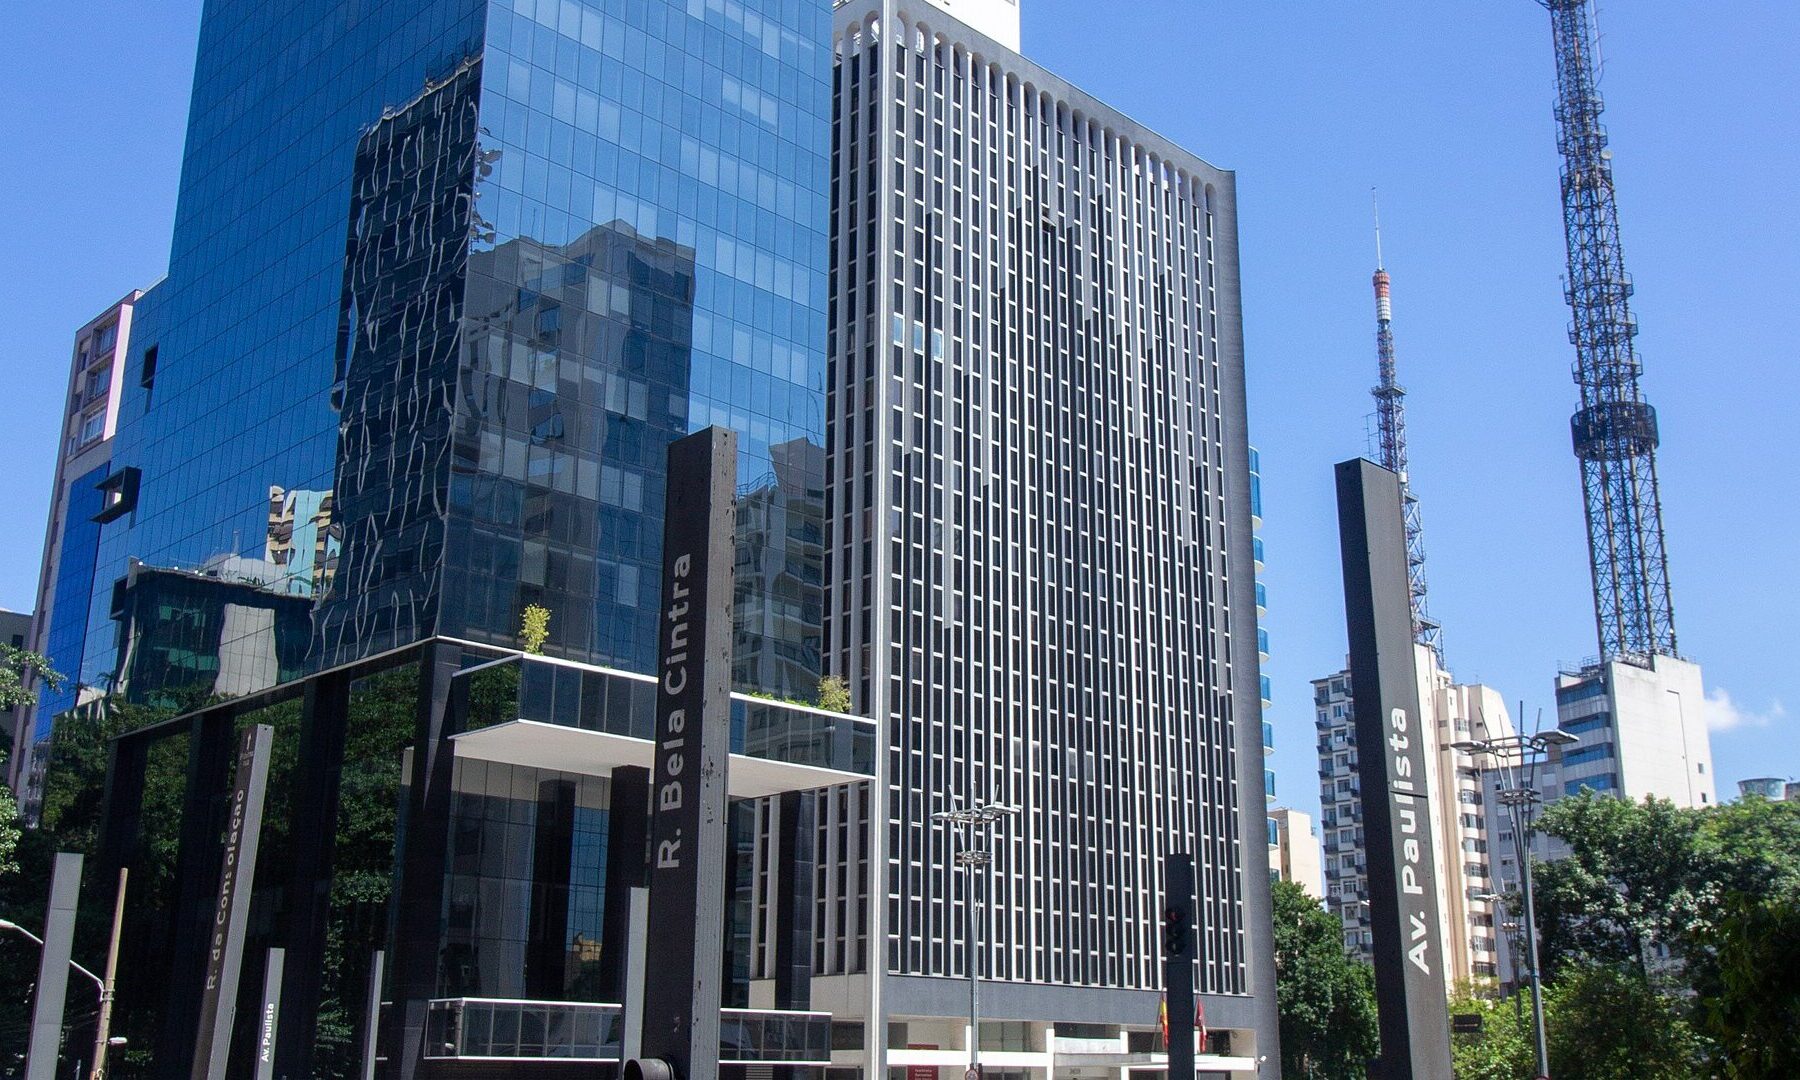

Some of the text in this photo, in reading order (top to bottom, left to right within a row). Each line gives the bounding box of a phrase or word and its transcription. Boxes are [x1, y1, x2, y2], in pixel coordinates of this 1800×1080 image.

[657, 553, 691, 869] R. Bela Cintra
[1388, 707, 1430, 976] Av. Paulista
[206, 969, 218, 990] R.
[212, 933, 223, 961] da
[261, 1003, 275, 1063] Av. Paulista
